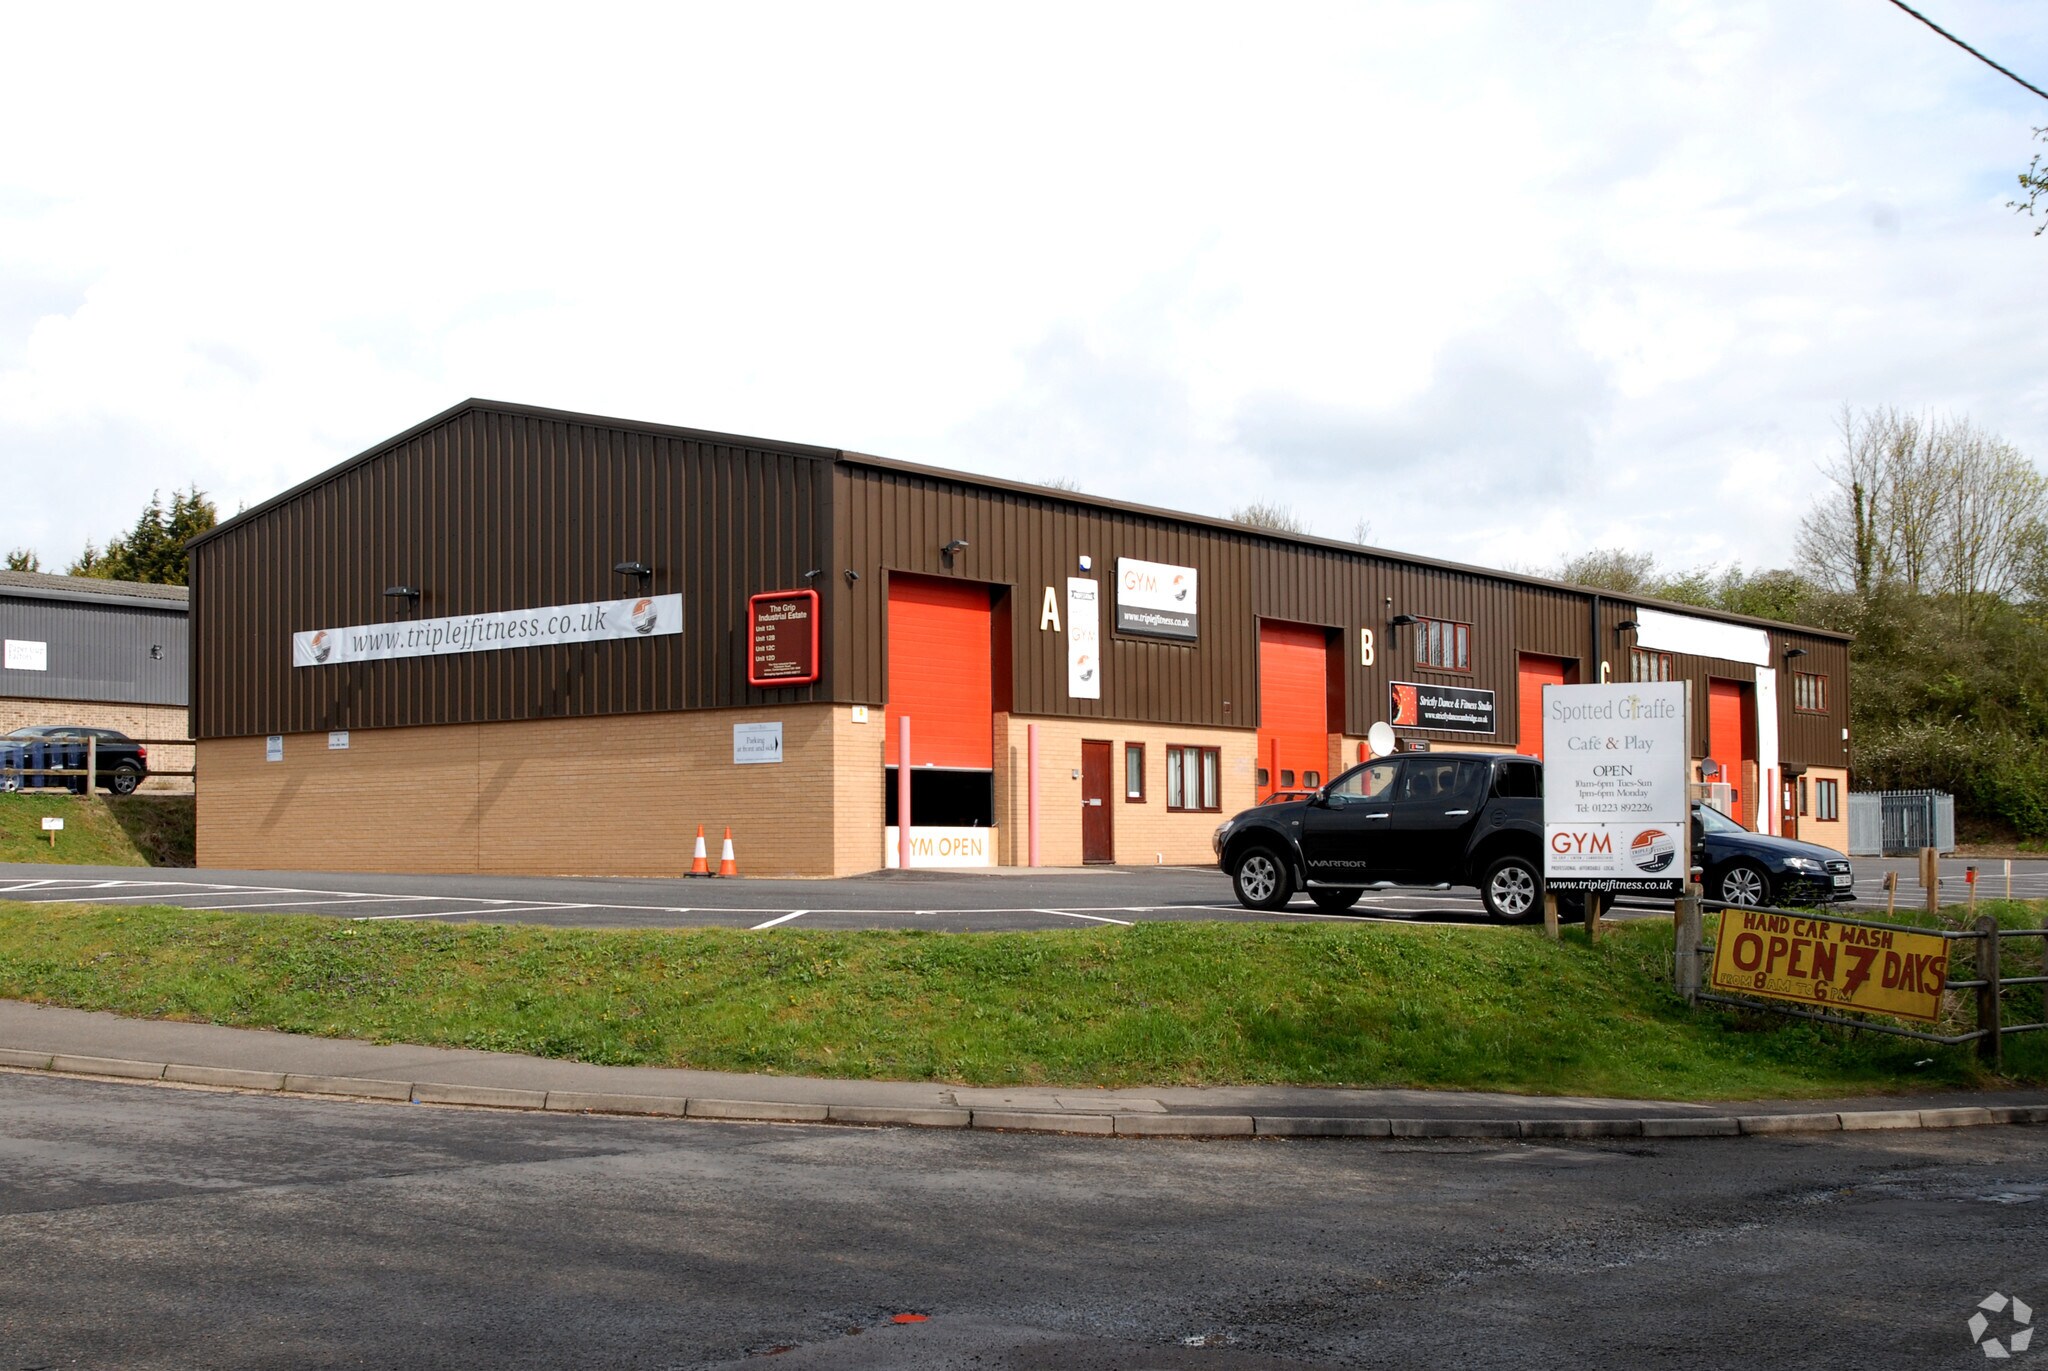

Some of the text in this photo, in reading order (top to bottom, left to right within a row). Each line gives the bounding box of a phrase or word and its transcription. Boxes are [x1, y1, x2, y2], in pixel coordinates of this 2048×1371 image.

[1124, 570, 1158, 593] GYM
[758, 611, 807, 622] Industrial Estate
[782, 604, 796, 613] Grip
[1040, 586, 1061, 632] A
[1124, 612, 1190, 627] www.triplejfitness.co.uk
[353, 606, 607, 652] www.triplejfitness.co.uk
[1360, 628, 1374, 666] B
[1419, 695, 1438, 709] Strictly
[1438, 697, 1454, 708] Dance
[1460, 699, 1477, 710] Fitness
[1477, 700, 1492, 712] Studio
[1552, 694, 1675, 723] Spotted Giraffe
[1567, 735, 1654, 753] Café & Play
[1593, 765, 1633, 777] OPEN
[1575, 779, 1652, 790] 10am-6pm Tues-Sun
[1579, 789, 1648, 800] 1pm-6pm Monday
[1592, 803, 1618, 813] 01223
[1620, 803, 1653, 813] 892226
[897, 837, 982, 856] YM OPEN
[1551, 832, 1612, 854] GYM
[1308, 860, 1366, 868] WARRIOR
[1550, 880, 1673, 892] www.triplejfitness.co.uk
[1743, 912, 1894, 950] HAND CAR WASH
[1732, 932, 1947, 998] OPEN 7 DAYS
[1720, 972, 1752, 988] FROM
[1797, 982, 1813, 996] TO
